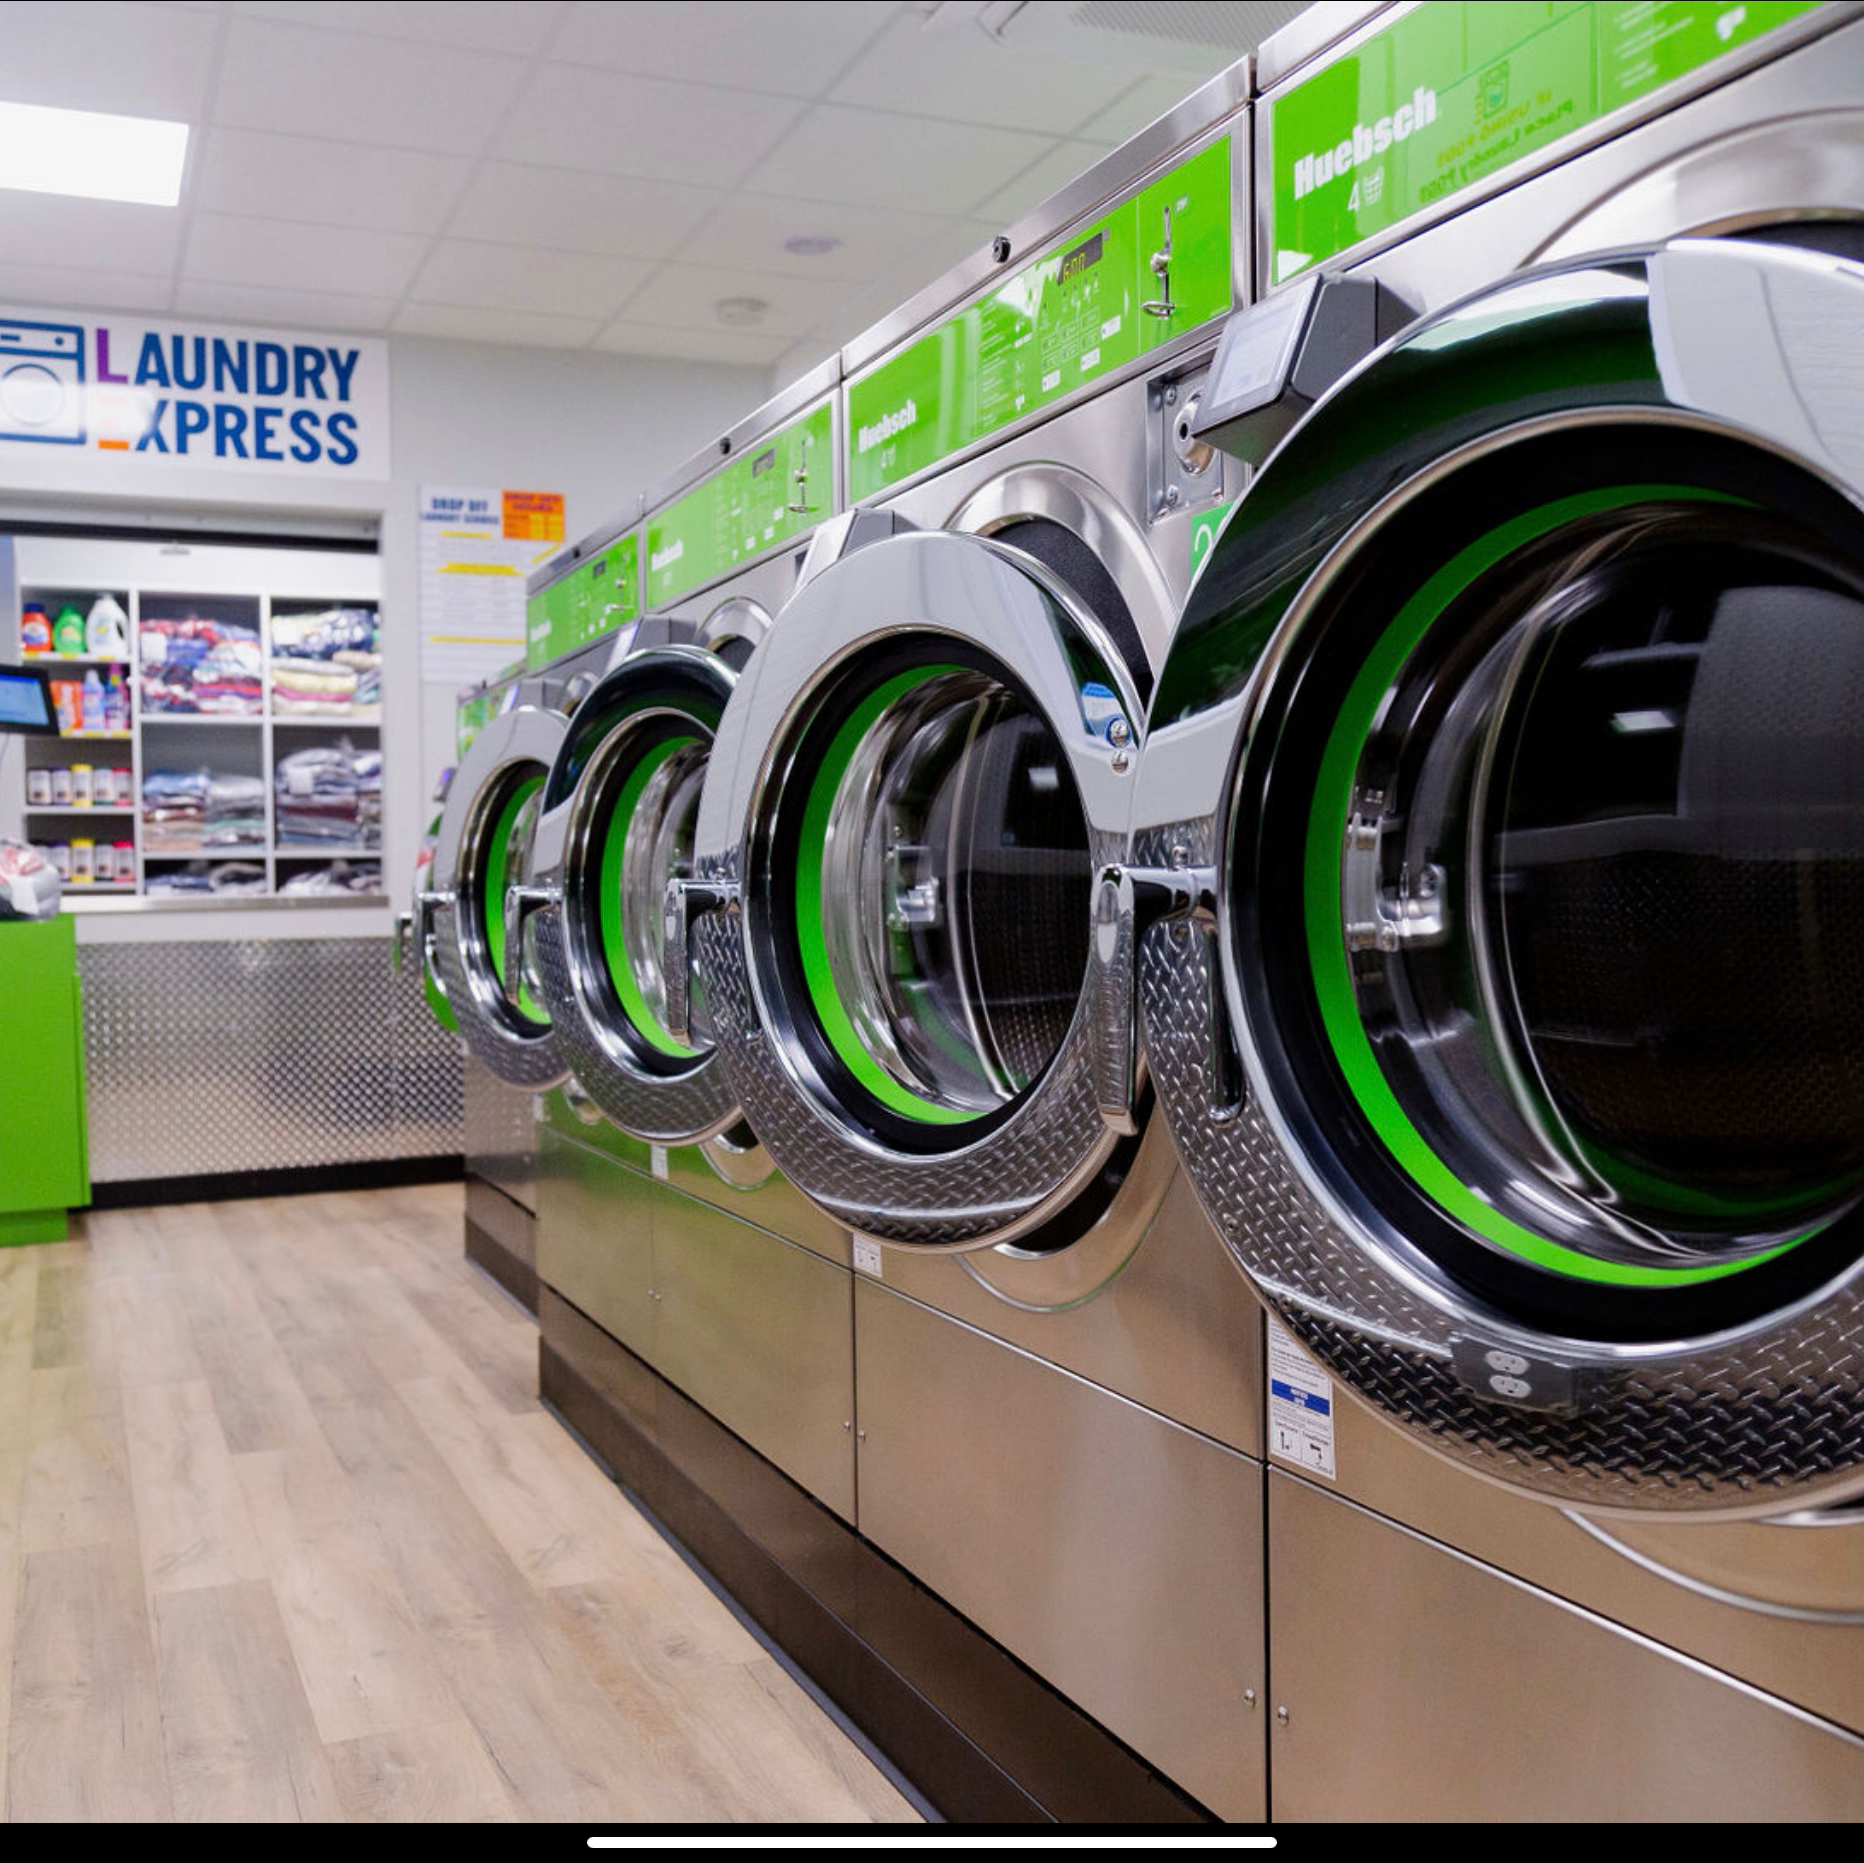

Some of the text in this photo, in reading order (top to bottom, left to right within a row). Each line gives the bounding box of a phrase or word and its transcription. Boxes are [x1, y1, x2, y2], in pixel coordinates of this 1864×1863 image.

[1294, 86, 1437, 200] Huebsch
[96, 327, 360, 402] LAUNDRY
[97, 394, 359, 466] XPRESS
[858, 399, 917, 454] Huebsch
